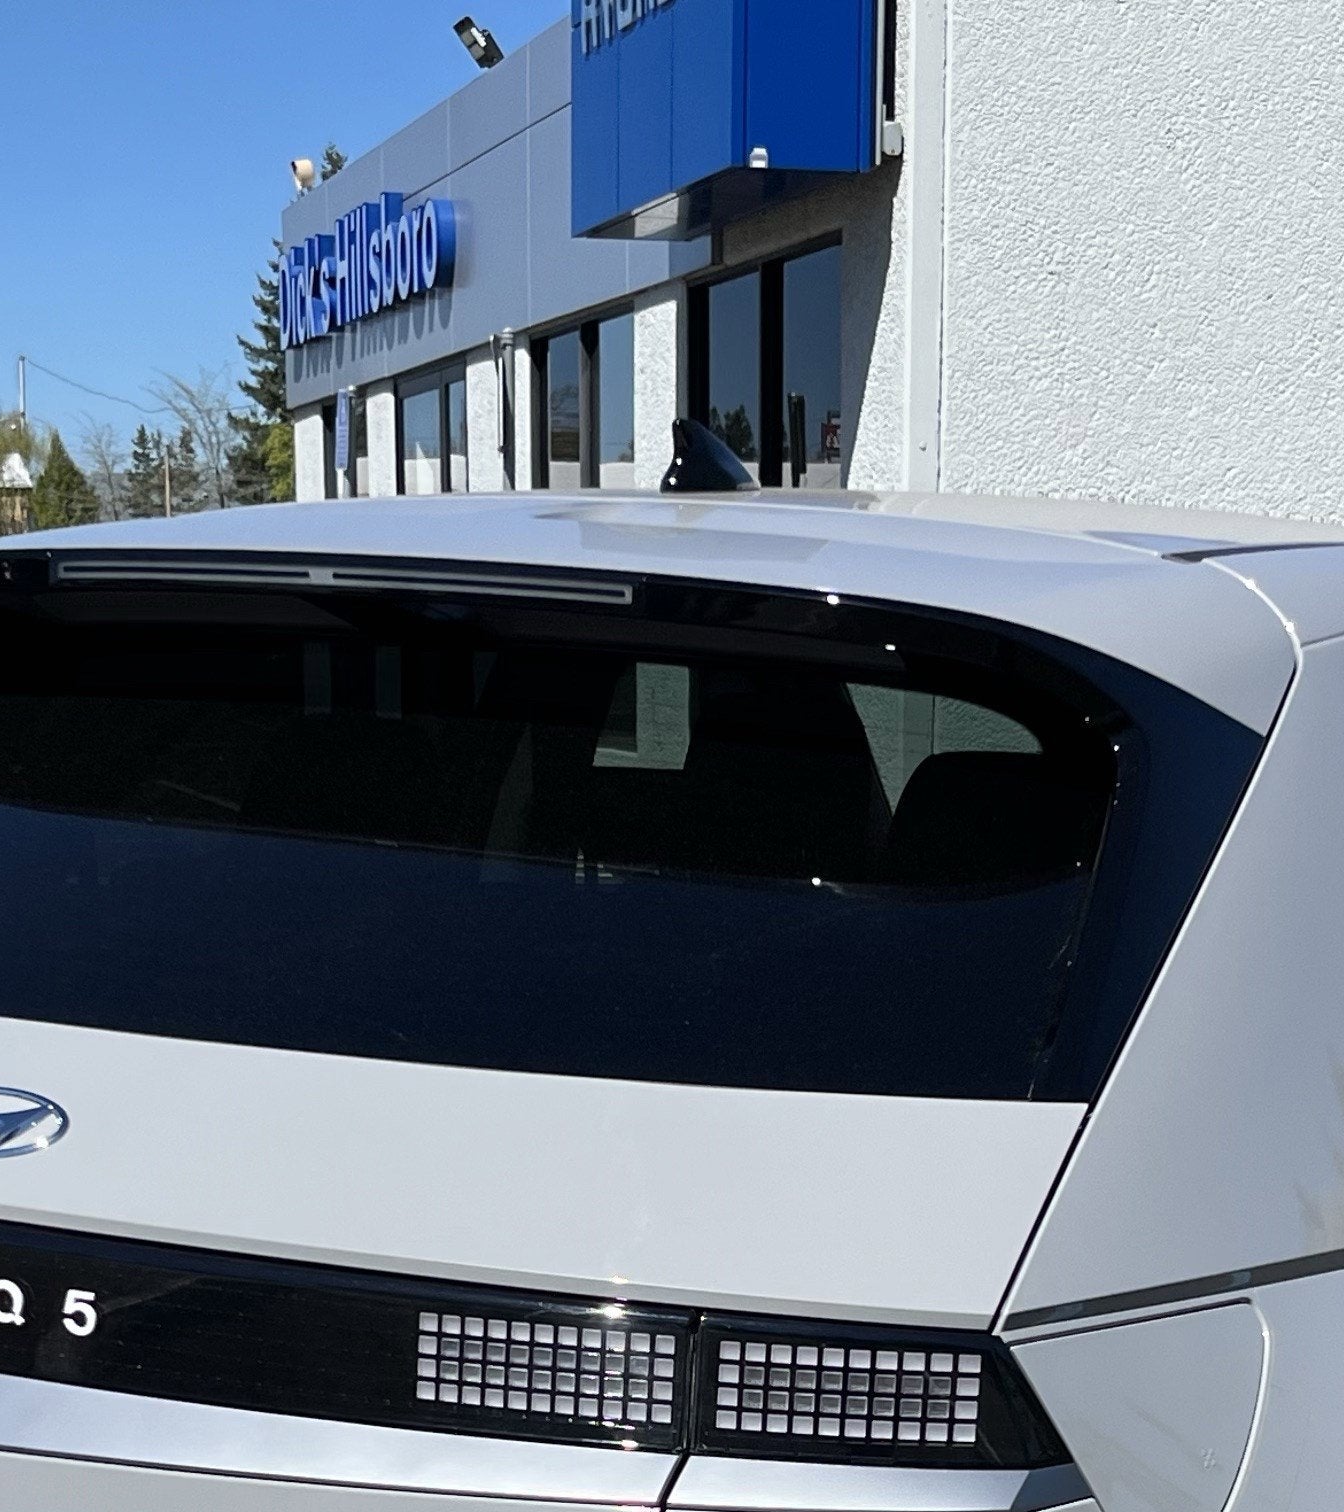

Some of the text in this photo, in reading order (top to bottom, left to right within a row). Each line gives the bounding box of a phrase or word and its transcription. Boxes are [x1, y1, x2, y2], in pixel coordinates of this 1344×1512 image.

[279, 193, 438, 350] Dick's Hillsboro
[61, 1288, 98, 1337] 5
